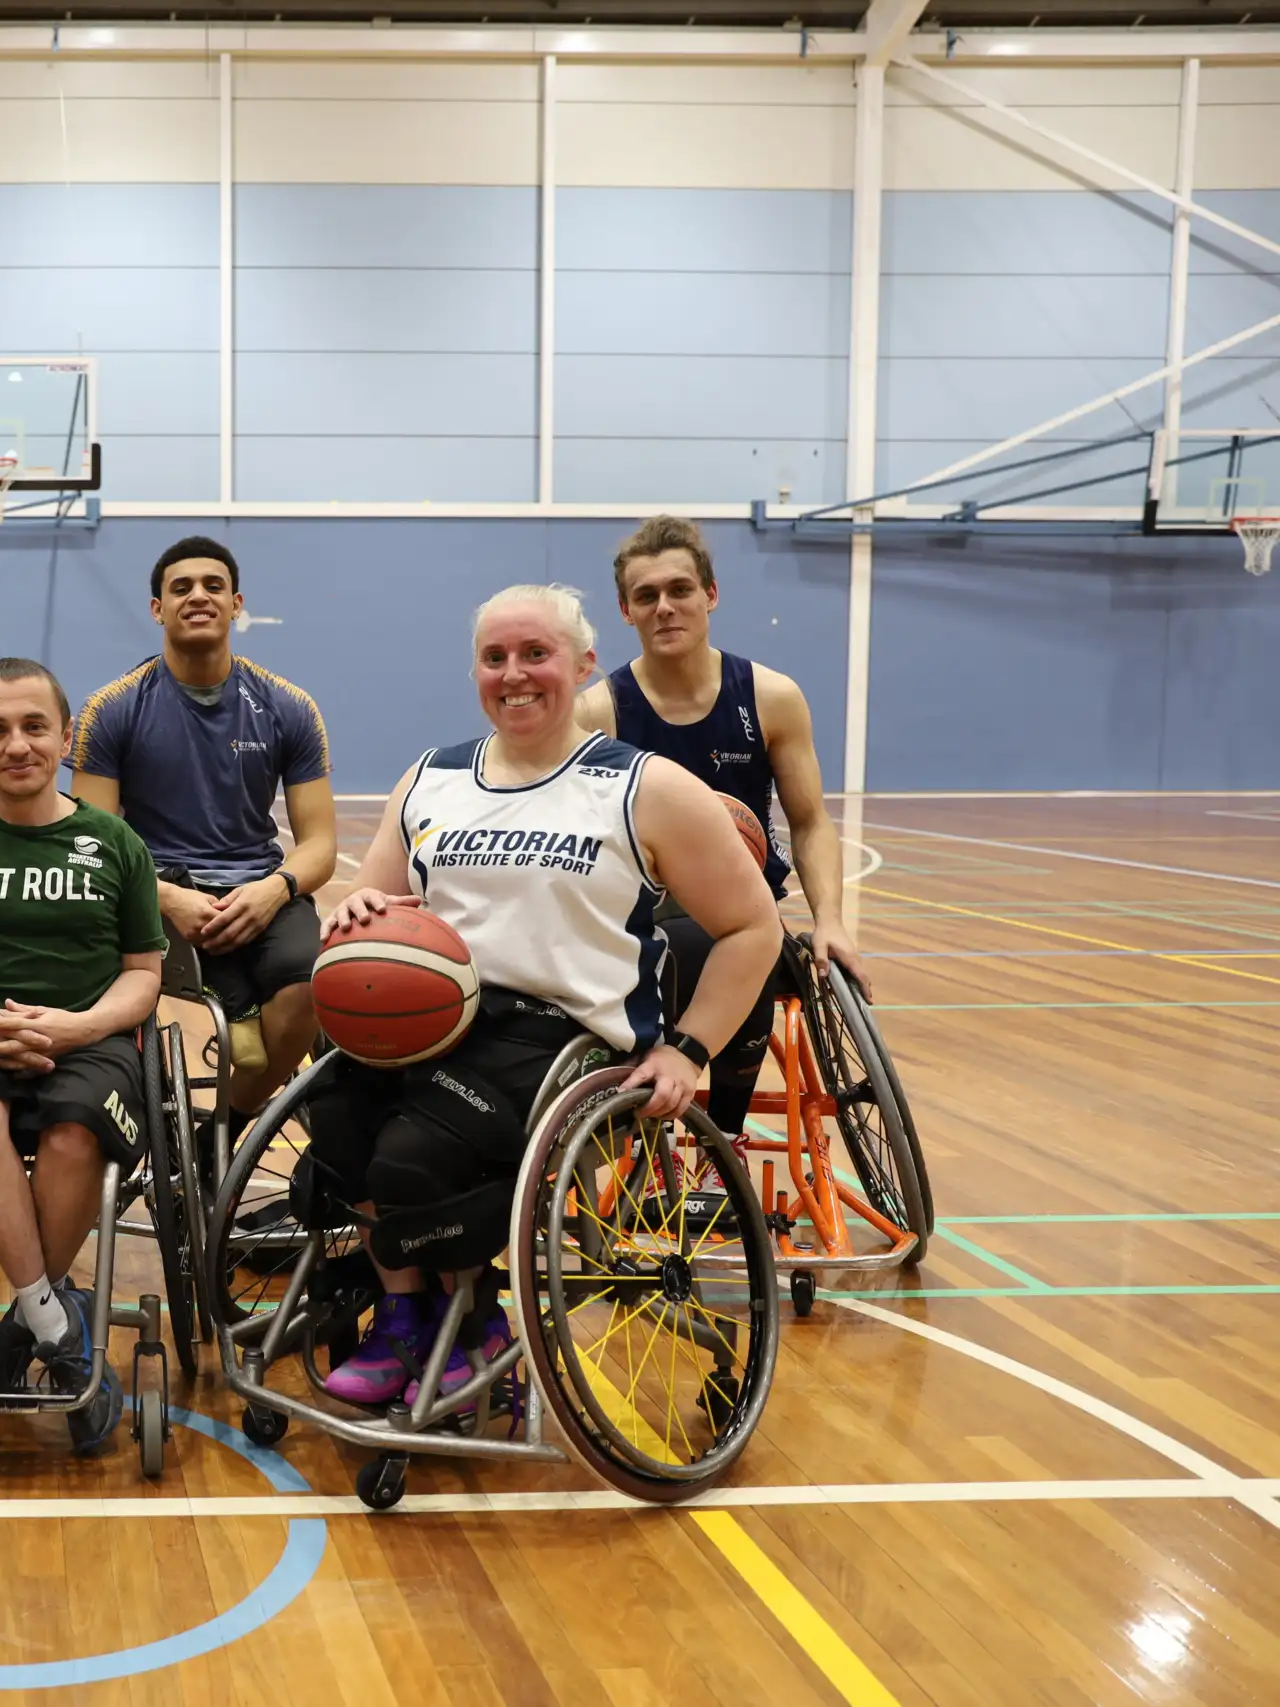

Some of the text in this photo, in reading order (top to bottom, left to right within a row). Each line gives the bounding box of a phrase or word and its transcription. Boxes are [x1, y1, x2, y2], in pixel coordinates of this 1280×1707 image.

[738, 706, 756, 742] 2XU
[578, 767, 620, 779] 2XU
[435, 829, 604, 863] VICTORIAN
[432, 853, 595, 876] INSTITUTE OF SPORT
[22, 867, 105, 901] ROLL.
[103, 1089, 139, 1146] AUS
[558, 1085, 620, 1144] SPINERG
